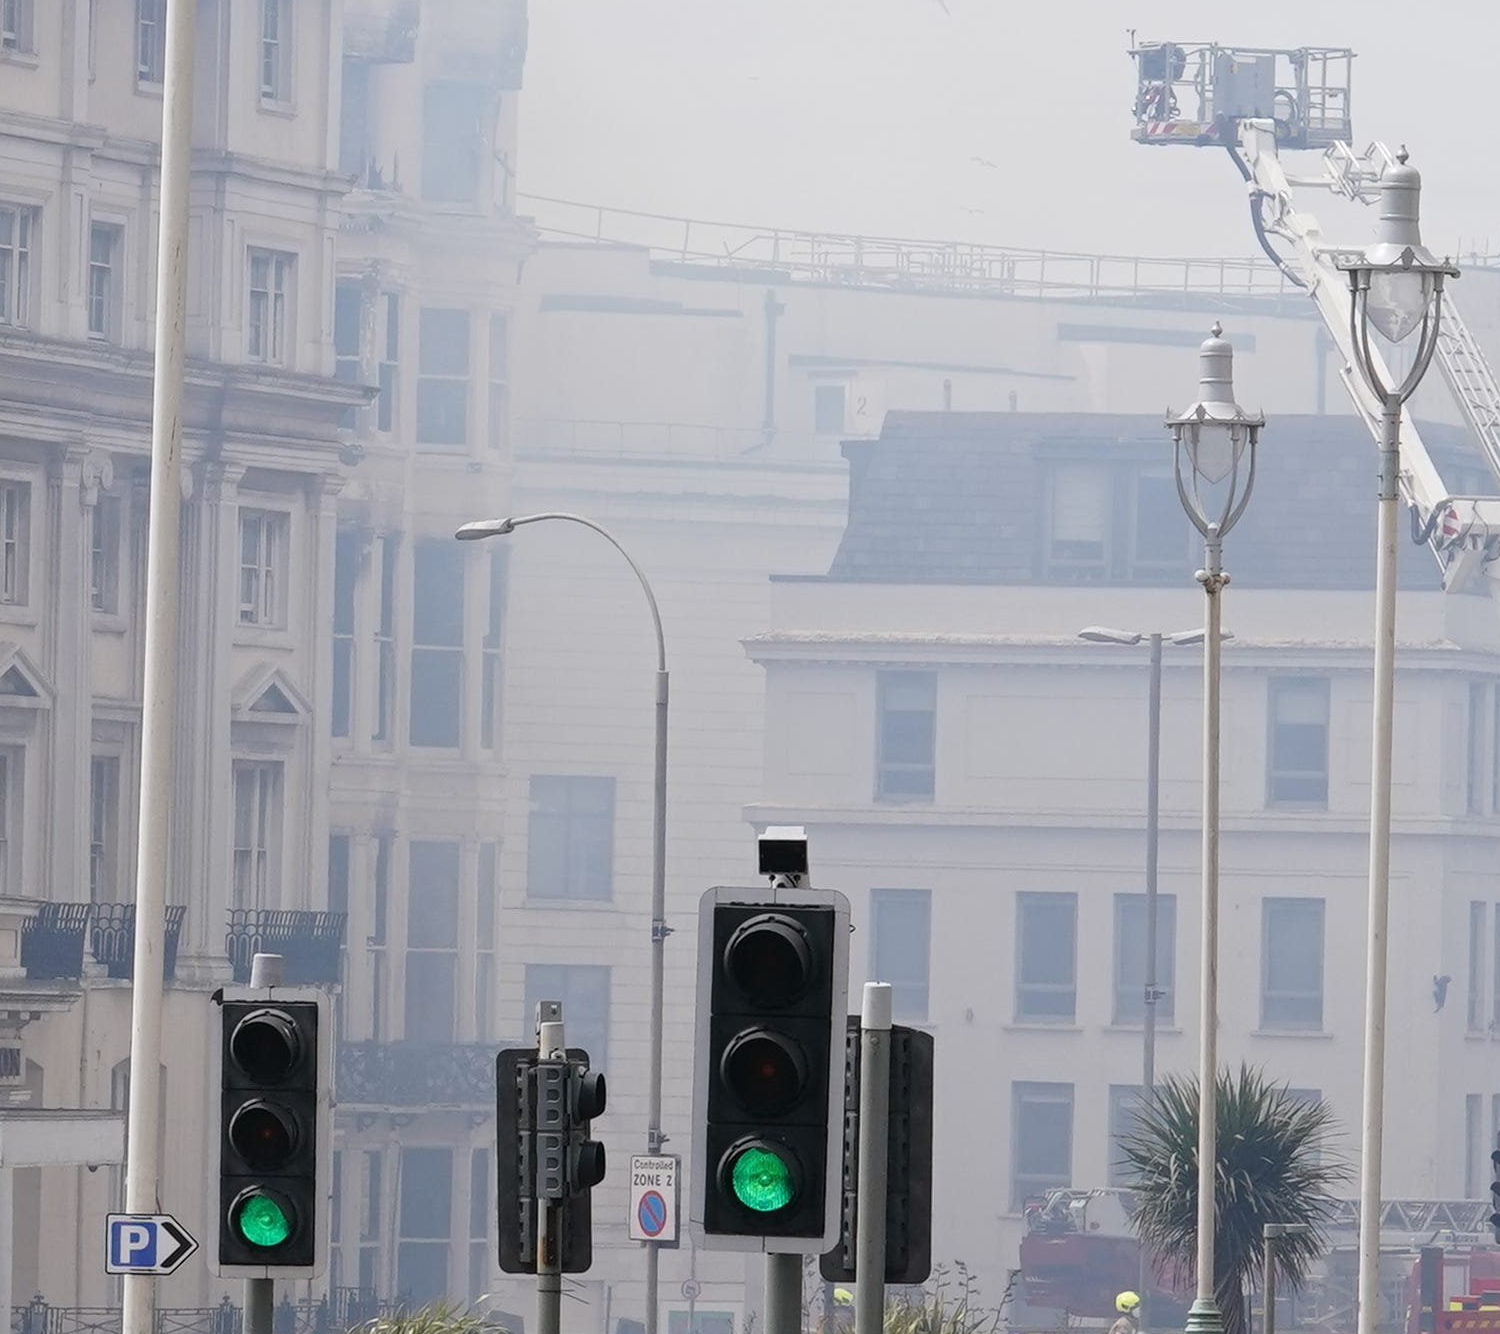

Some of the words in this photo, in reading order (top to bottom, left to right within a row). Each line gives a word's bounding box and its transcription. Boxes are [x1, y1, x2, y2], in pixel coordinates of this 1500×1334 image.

[633, 1158, 674, 1171] Controlled
[633, 1174, 661, 1187] ZONE
[666, 1175, 673, 1187] 2
[119, 1225, 150, 1264] P
